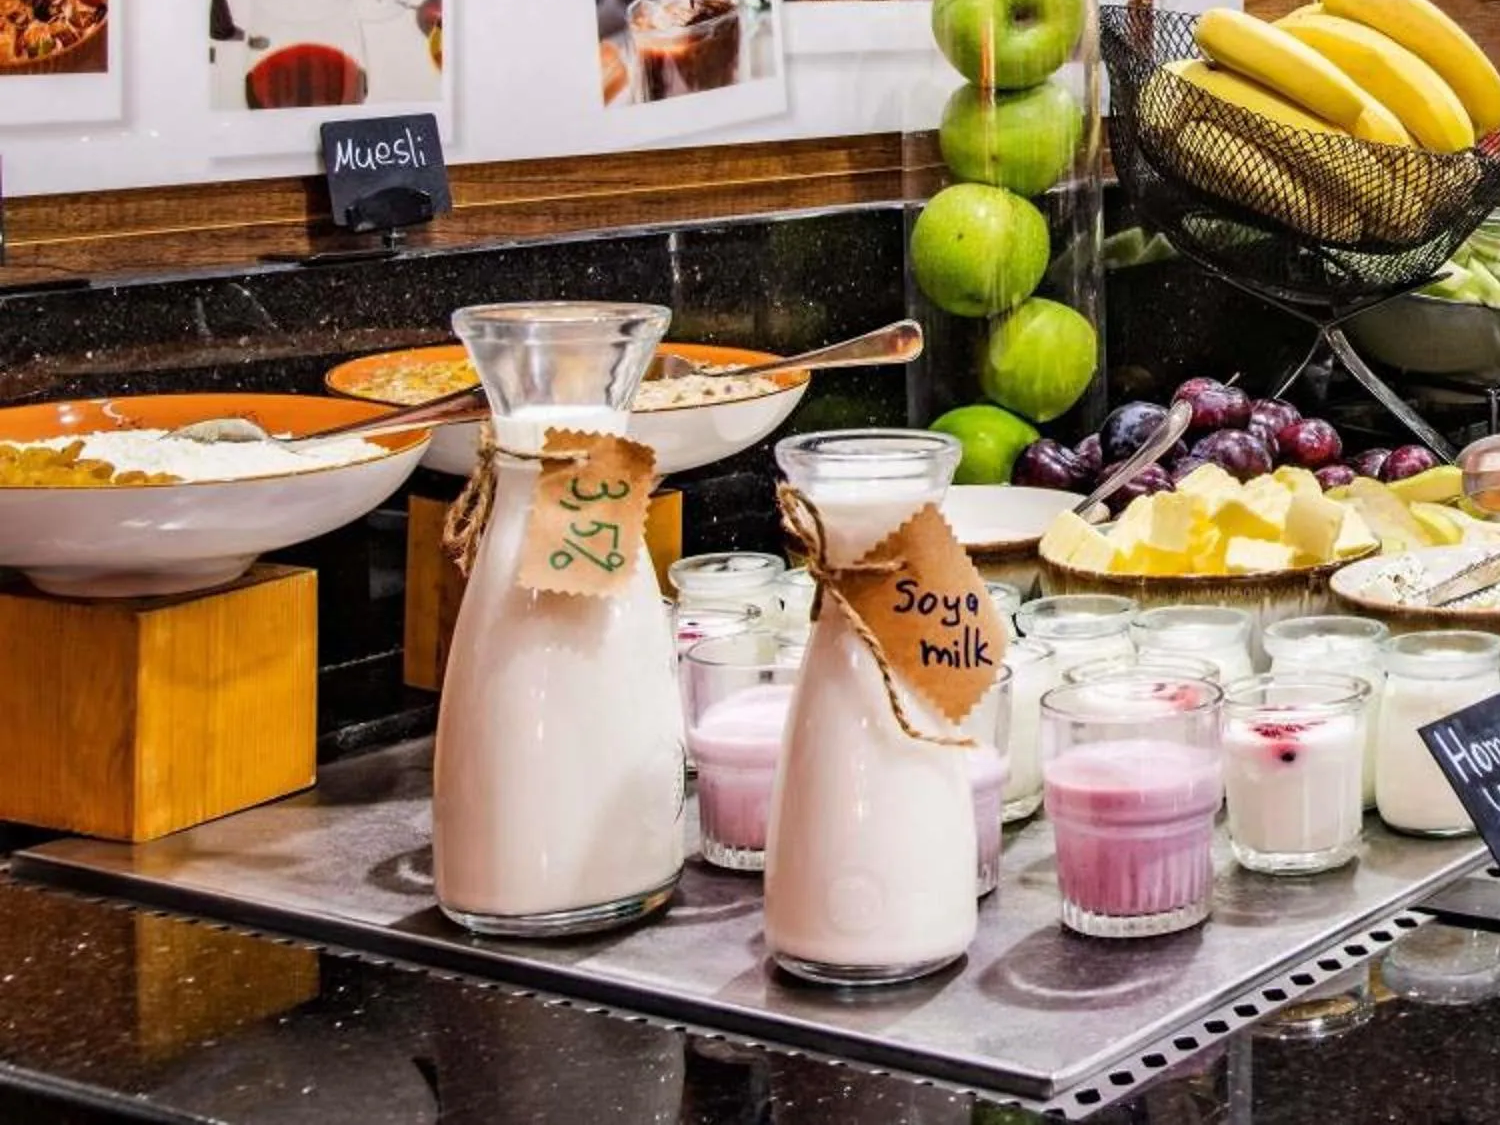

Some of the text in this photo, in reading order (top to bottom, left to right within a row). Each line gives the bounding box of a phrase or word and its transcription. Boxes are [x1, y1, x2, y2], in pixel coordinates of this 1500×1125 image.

[334, 127, 427, 173] Muesli
[549, 477, 630, 572] 3,5%
[893, 579, 979, 627] Soya
[920, 625, 993, 669] milk
